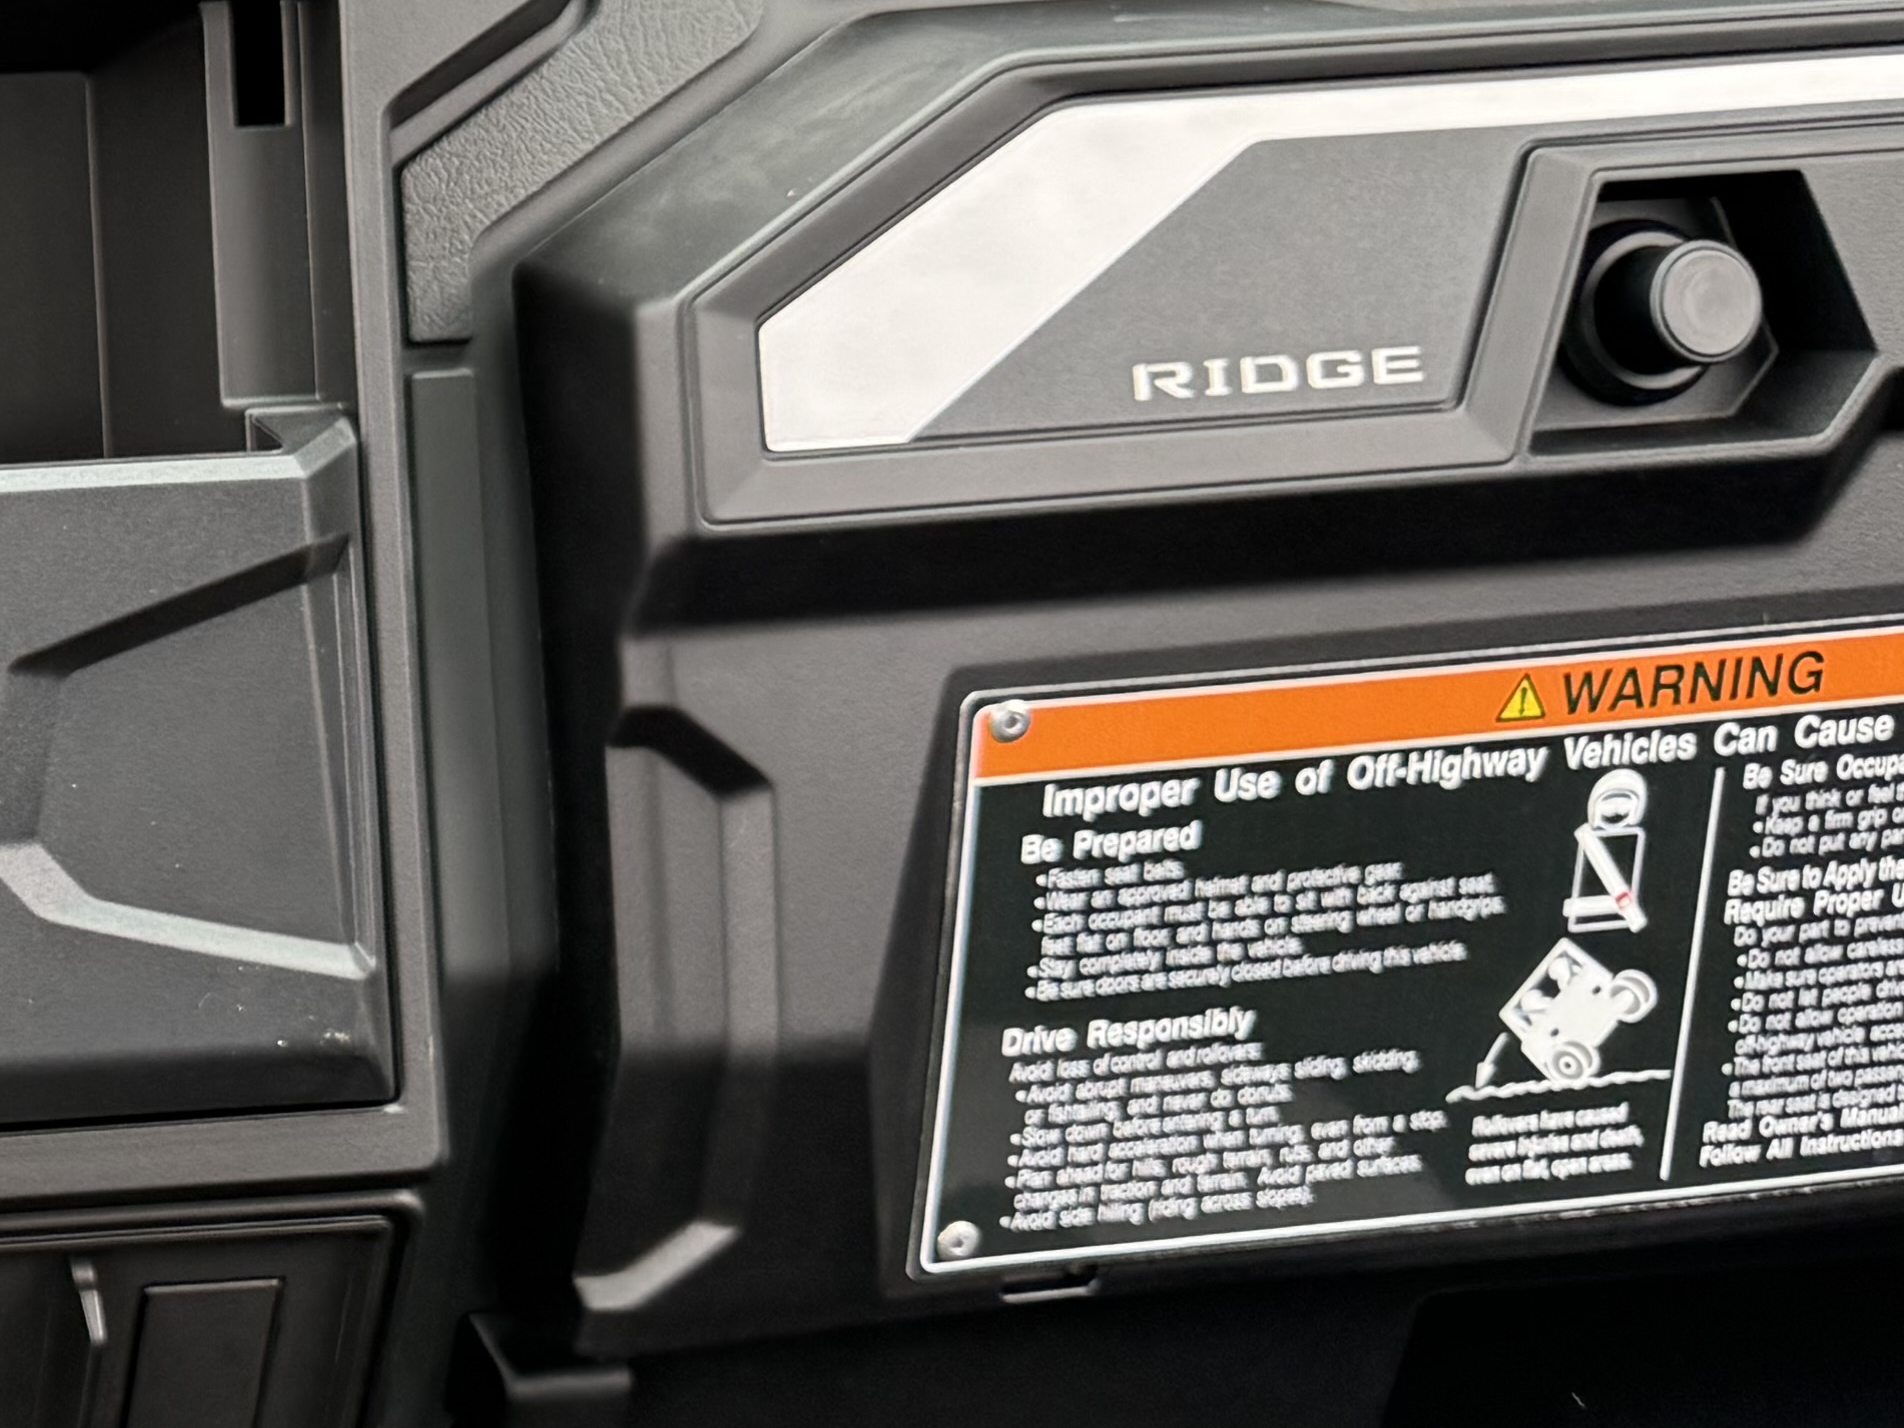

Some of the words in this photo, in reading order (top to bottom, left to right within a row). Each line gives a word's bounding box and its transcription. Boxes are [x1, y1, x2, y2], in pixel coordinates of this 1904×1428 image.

[1132, 345, 1424, 404] RIDGE
[1563, 651, 1825, 715] WARNING
[1043, 778, 1200, 821] Improper
[1214, 768, 1281, 802] Use
[1295, 759, 1334, 795] of
[1348, 743, 1549, 790] Off-Highway
[1564, 729, 1696, 770] Vehicles
[1714, 722, 1778, 757] Can
[1794, 715, 1895, 749] Cause
[1743, 763, 1772, 789] Be
[1780, 759, 1828, 785] Sure
[1021, 834, 1063, 864] Be
[1073, 820, 1202, 862] Prepared
[1762, 836, 1785, 857] Do
[1790, 835, 1815, 853] not
[1819, 833, 1845, 855] put
[1728, 870, 1755, 896] Be
[1757, 866, 1800, 893] Sure
[1802, 865, 1822, 889] to
[1823, 858, 1877, 891] Apply
[1724, 894, 1805, 927] Require
[1813, 889, 1884, 917] Proper
[1734, 926, 1757, 946] Do
[1748, 948, 1771, 969] Do
[1775, 947, 1800, 965] not
[1742, 992, 1764, 1012] Do
[1769, 991, 1794, 1009] not
[1002, 1025, 1077, 1056] Drive
[1087, 1006, 1256, 1050] Responsibly
[1738, 1014, 1761, 1033] Do
[1703, 1119, 1752, 1143] Read
[1759, 1111, 1833, 1137] Owner's
[1699, 1143, 1761, 1167] Follow
[1766, 1138, 1793, 1159] All
